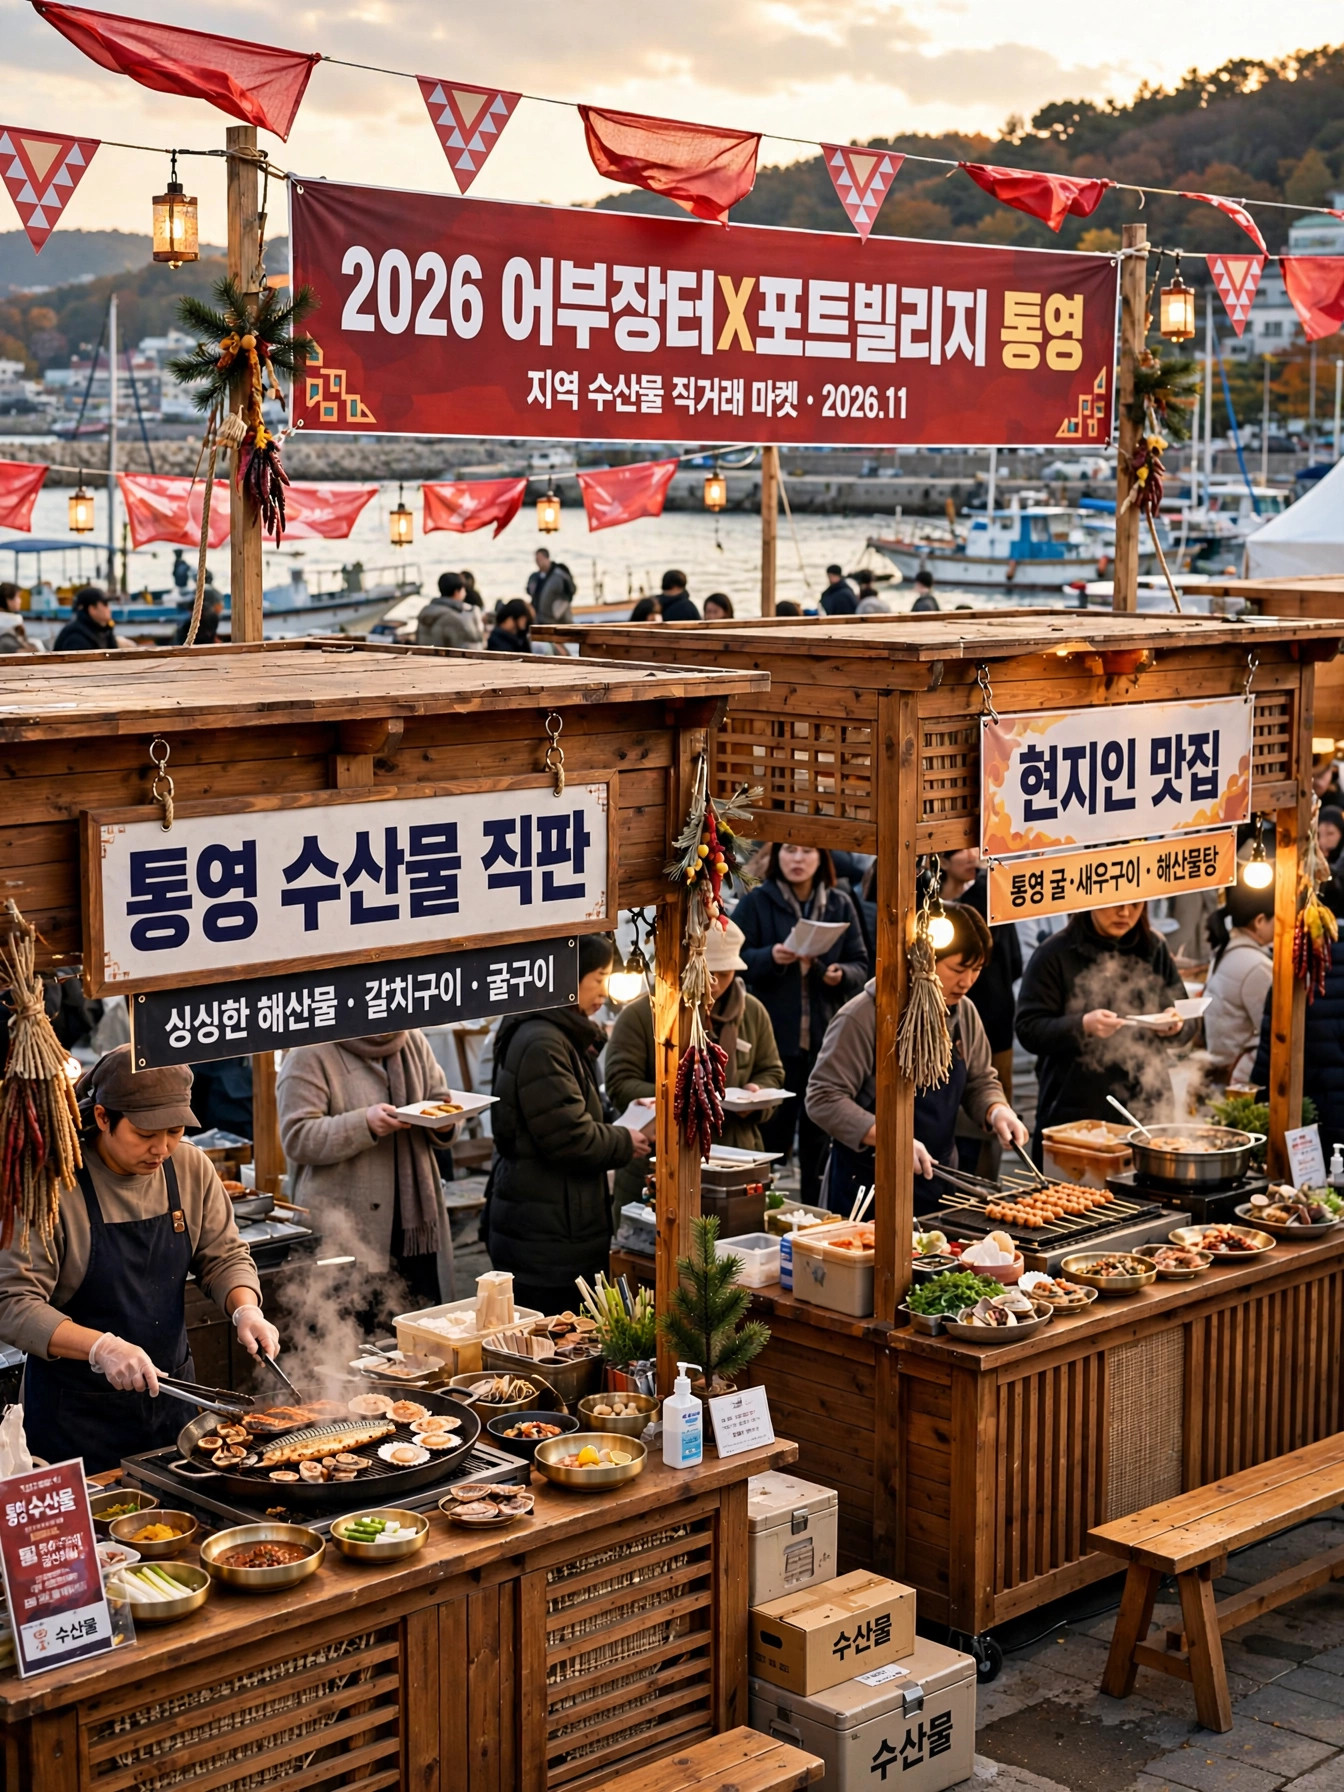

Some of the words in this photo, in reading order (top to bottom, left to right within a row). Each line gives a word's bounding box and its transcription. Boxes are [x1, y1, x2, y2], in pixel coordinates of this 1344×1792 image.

[342, 246, 483, 339] 2026
[1001, 291, 1083, 370] 통영
[527, 369, 578, 410] 지역
[588, 373, 664, 413] 수산물
[672, 377, 744, 416] 직거래
[752, 380, 797, 417] 마켓
[822, 384, 906, 418] 2026.11
[1020, 738, 1135, 822] 현지인
[1150, 730, 1219, 807] 맛집
[126, 840, 258, 951] 통영
[281, 822, 461, 931] 수산물
[481, 810, 590, 905] 직판
[1011, 870, 1044, 907] 통영
[1157, 845, 1219, 882] 해산물탕
[165, 997, 249, 1047] 싱싱한
[258, 986, 337, 1032] 해산물
[365, 968, 462, 1019] 갈치구이
[487, 955, 553, 1001] 굴구이
[28, 1488, 76, 1518] 수산물
[56, 1617, 98, 1644] 수산물
[832, 1613, 892, 1661] 수산물
[870, 1709, 953, 1781] 수산물
